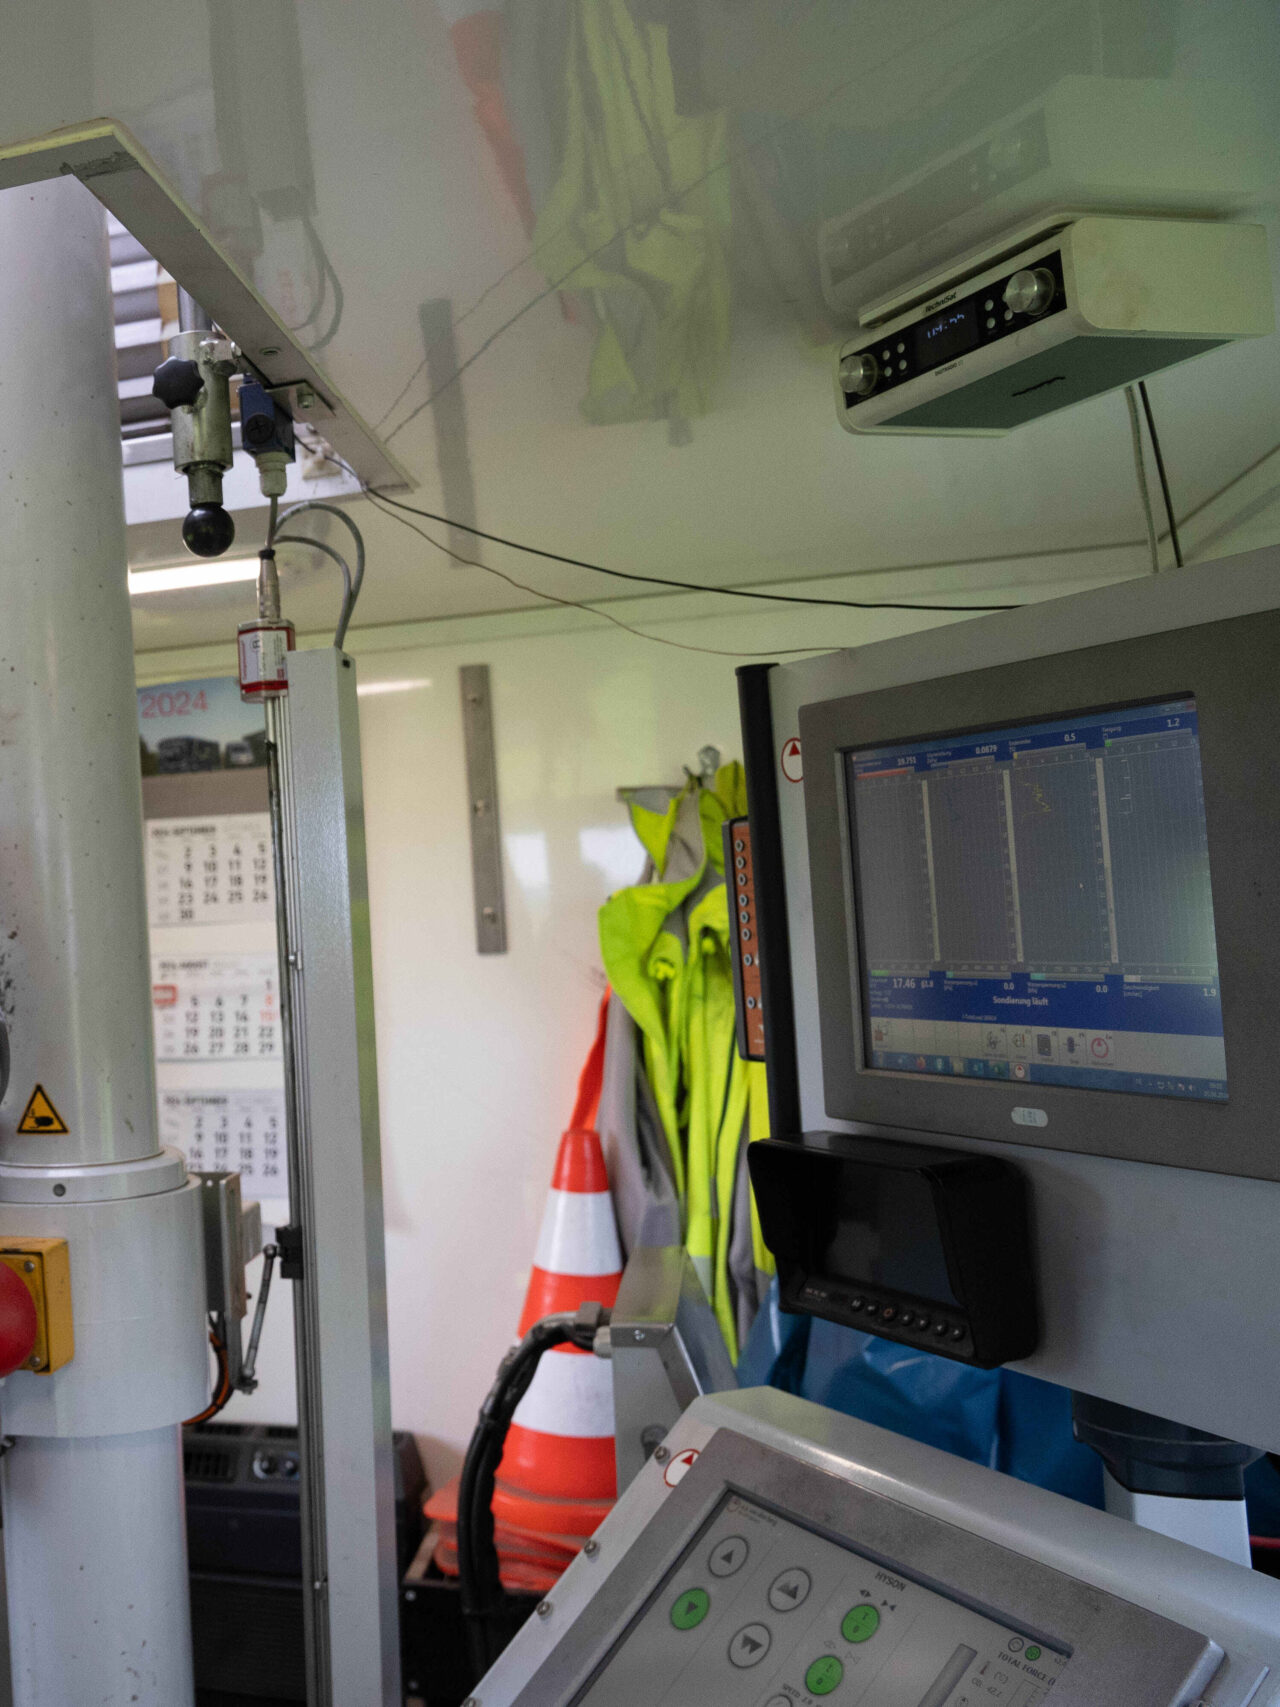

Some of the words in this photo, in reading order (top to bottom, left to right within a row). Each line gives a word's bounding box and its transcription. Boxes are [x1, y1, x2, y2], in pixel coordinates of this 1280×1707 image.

[140, 689, 209, 719] 2024
[893, 978, 916, 989] 17.46
[1203, 987, 1217, 997] 1.9
[992, 995, 1031, 1008] Sondierung
[1032, 997, 1049, 1006] läuft
[875, 1571, 907, 1592] HYSON
[998, 1651, 1022, 1669] TOTAL
[1022, 1663, 1048, 1681] FORCE
